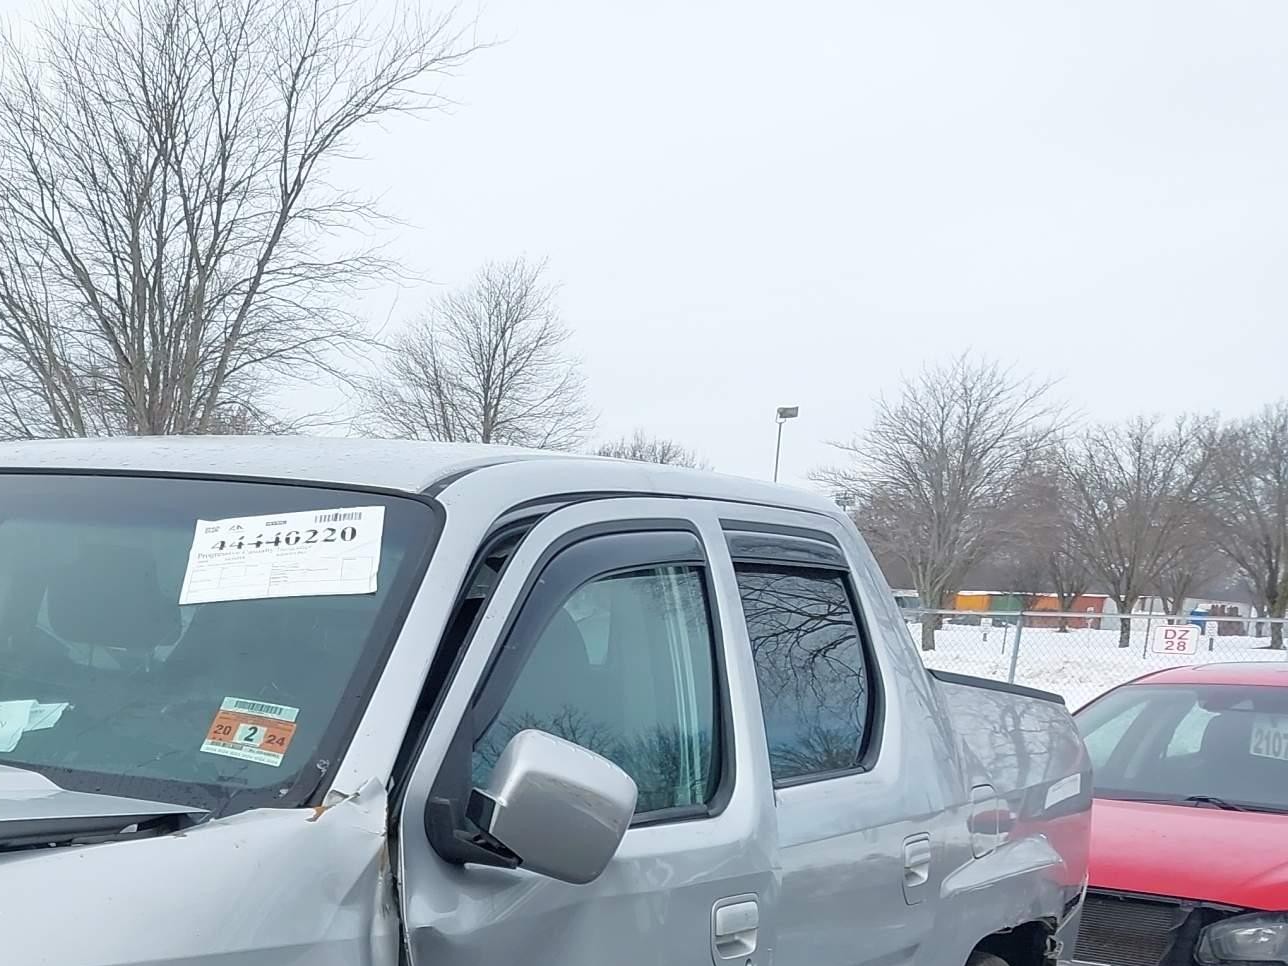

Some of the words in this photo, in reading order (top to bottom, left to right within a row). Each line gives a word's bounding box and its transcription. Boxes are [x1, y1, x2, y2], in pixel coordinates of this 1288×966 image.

[1164, 629, 1190, 640] DZ
[1164, 641, 1186, 651] 28
[213, 724, 232, 736] 20
[243, 726, 258, 742] 2
[266, 734, 285, 747] 24
